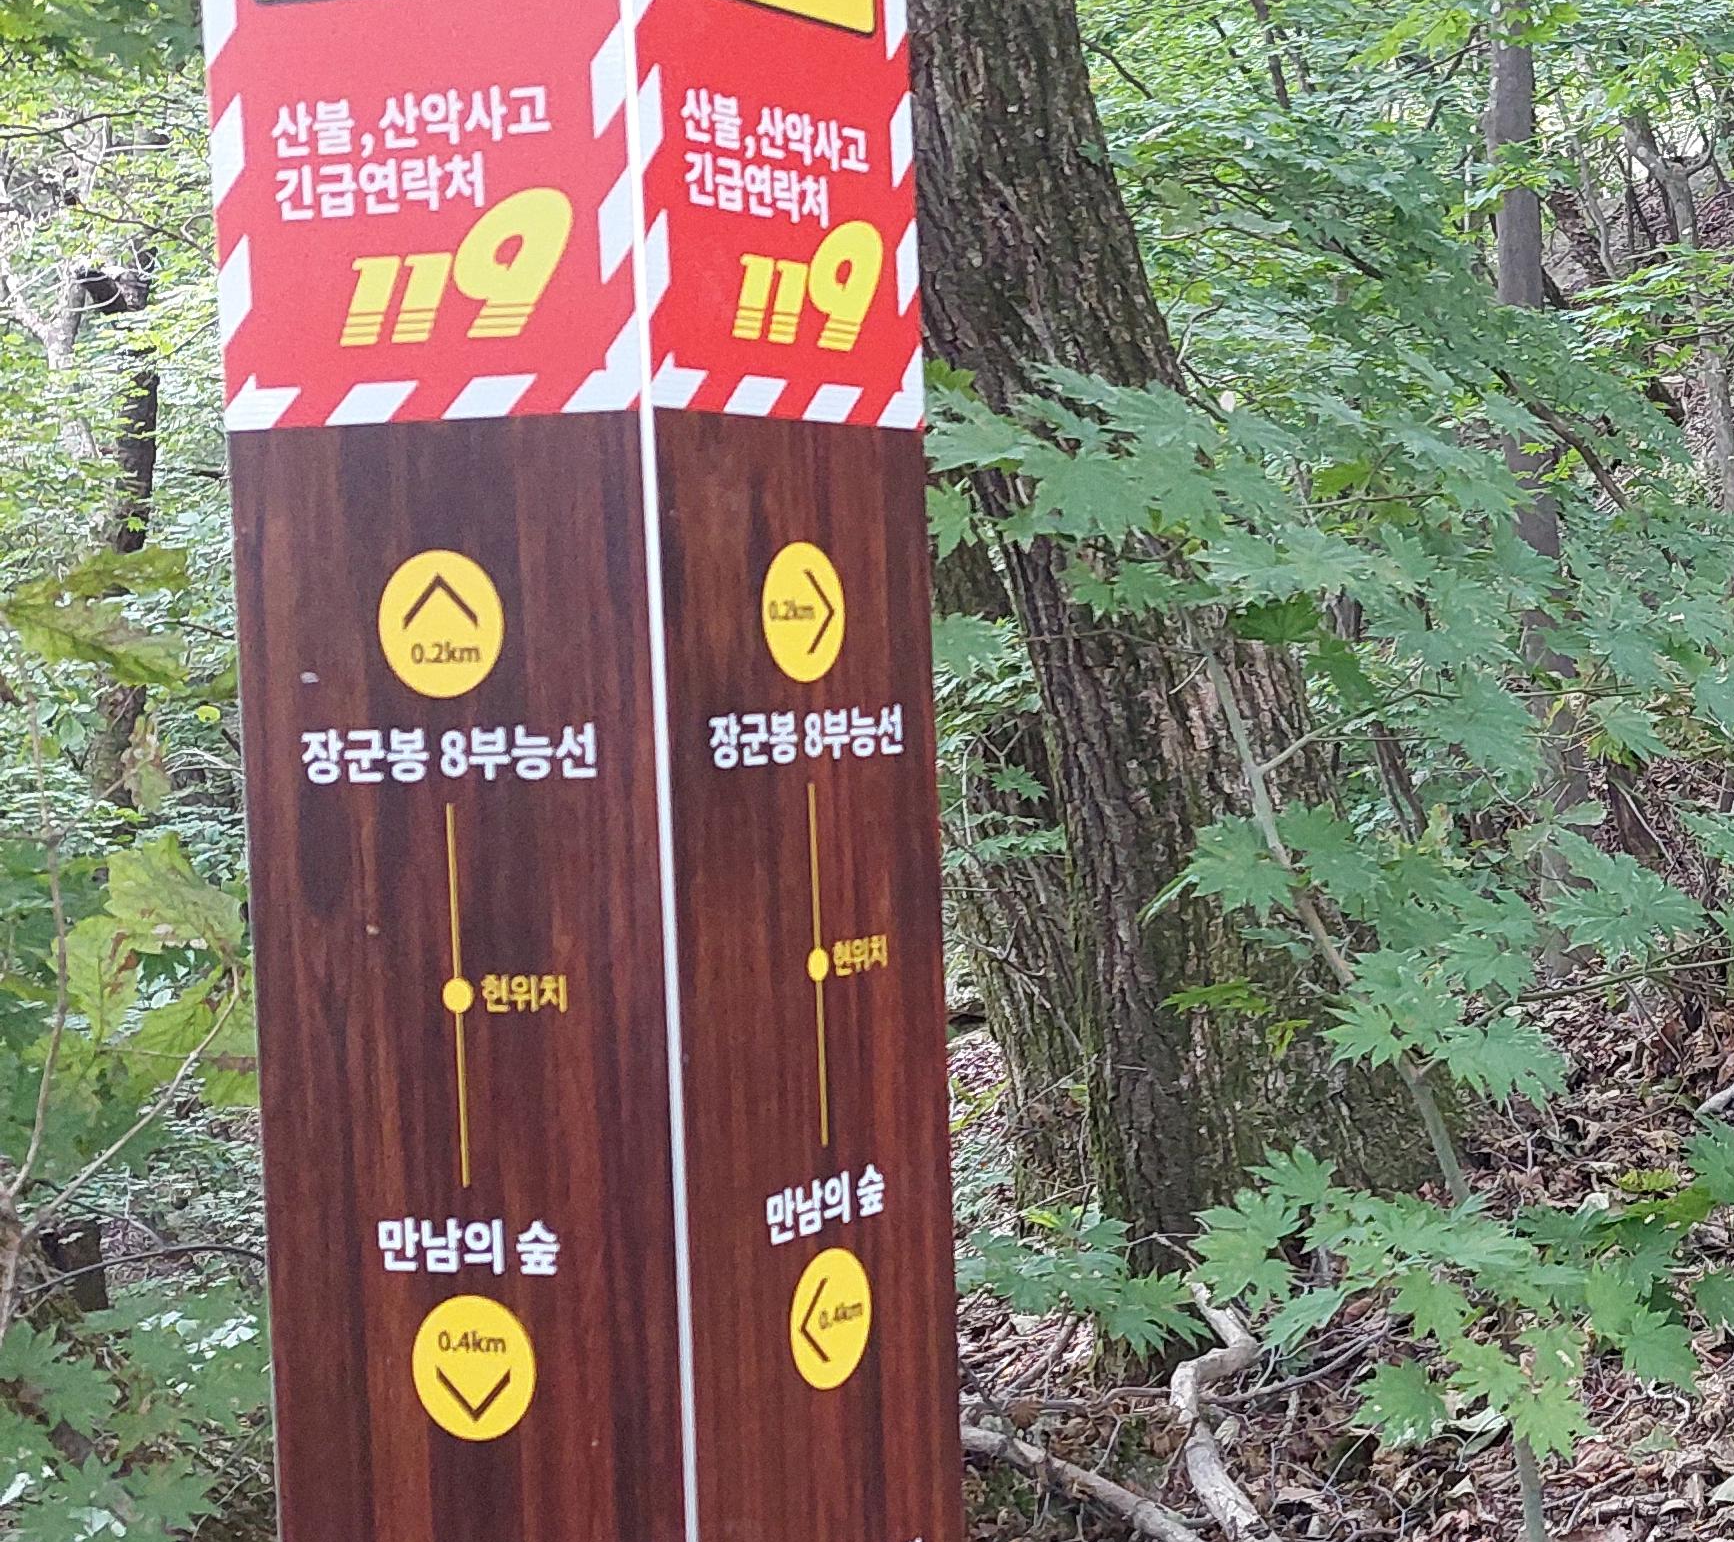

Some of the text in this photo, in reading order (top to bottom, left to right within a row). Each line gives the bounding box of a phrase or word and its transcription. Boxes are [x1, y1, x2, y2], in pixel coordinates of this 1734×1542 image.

[275, 150, 486, 222] 긴급연락처
[684, 151, 829, 230] 긴급연락처
[340, 187, 573, 347] 119
[731, 219, 884, 352] 119
[768, 599, 816, 622] 0.2km
[411, 641, 480, 665] 0.2km
[301, 722, 598, 784] 장군봉 8부능선
[708, 704, 905, 770] 장군봉 8부능선
[831, 934, 889, 977] 현위치
[480, 973, 568, 1014] 현위치
[765, 1163, 885, 1246] 만남의 숲
[377, 1218, 559, 1276] 만남의 숲
[437, 1330, 507, 1355] 0.4km
[818, 1299, 864, 1331] 0.4km
